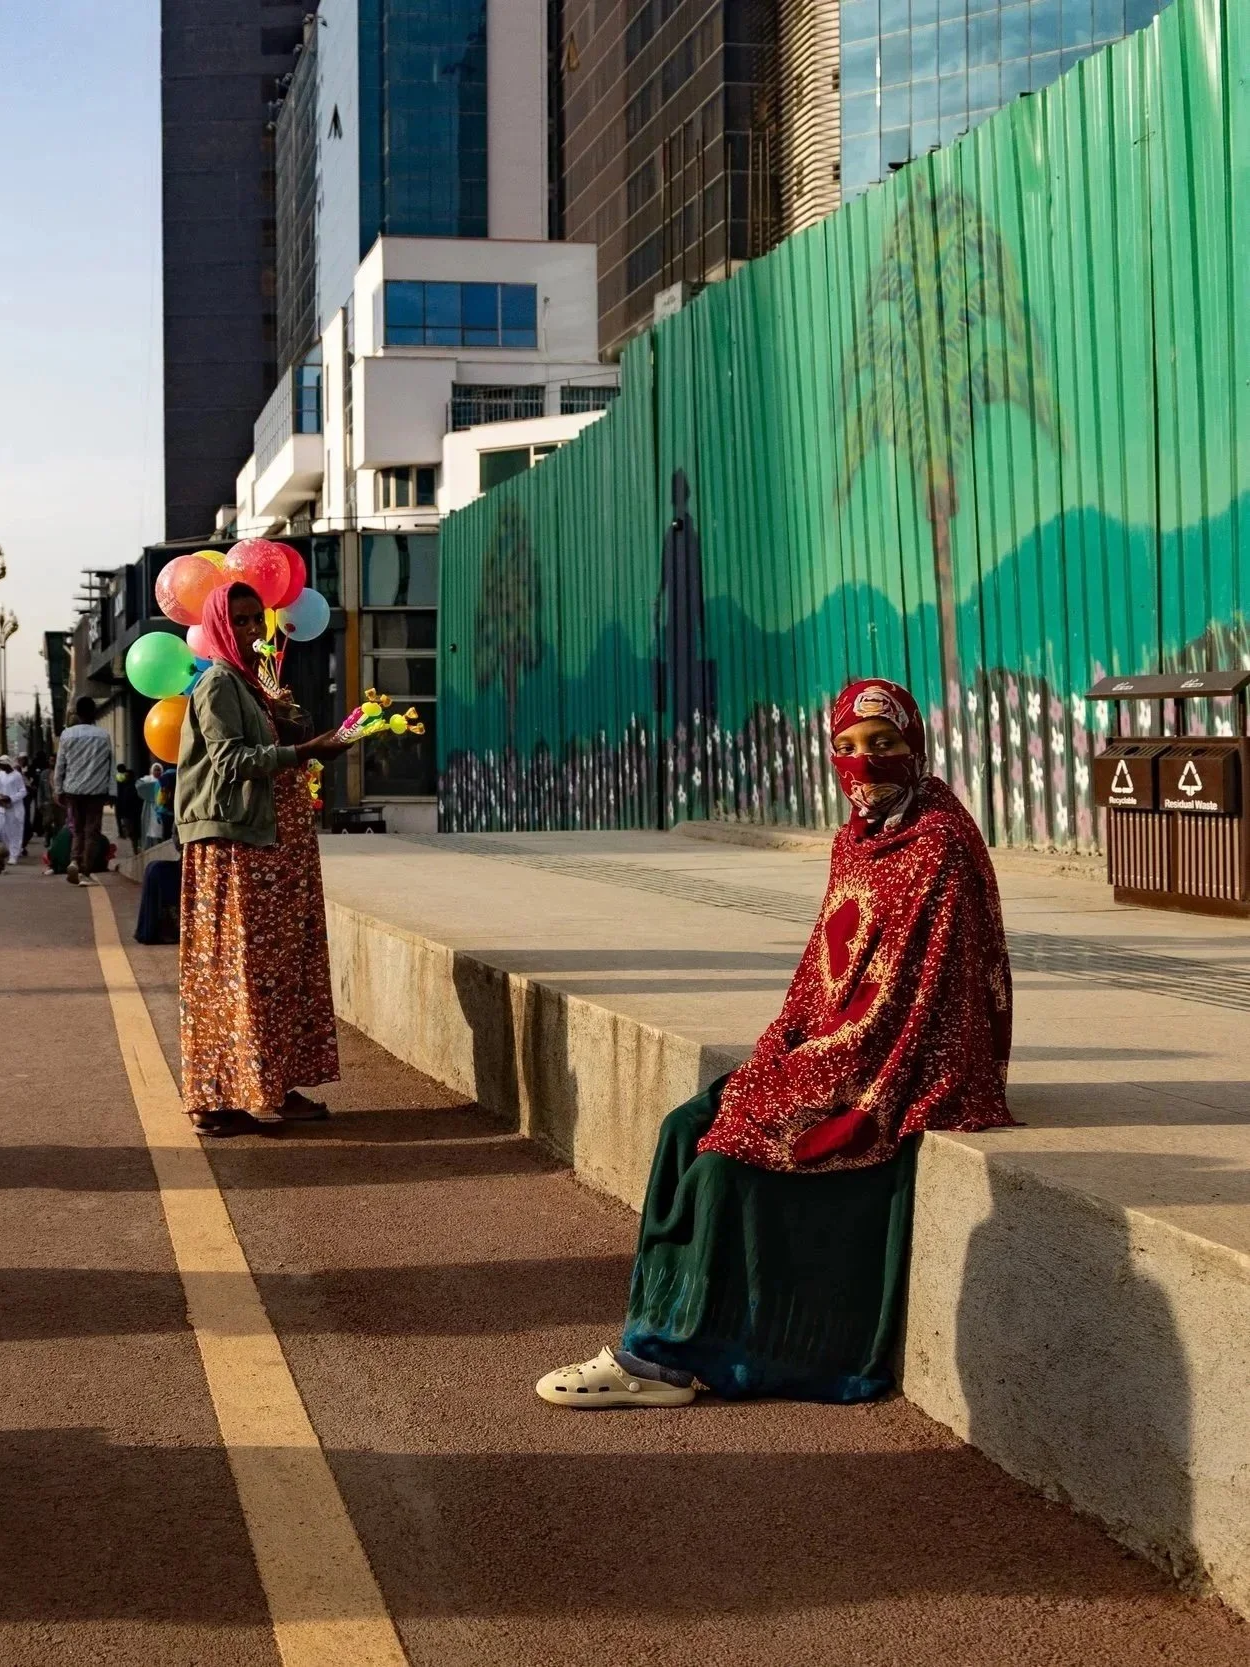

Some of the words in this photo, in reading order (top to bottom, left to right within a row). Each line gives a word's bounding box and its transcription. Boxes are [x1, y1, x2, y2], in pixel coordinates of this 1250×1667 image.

[1108, 796, 1137, 805] Recyclable
[1164, 799, 1194, 809] Residual
[1195, 800, 1218, 810] Waste
